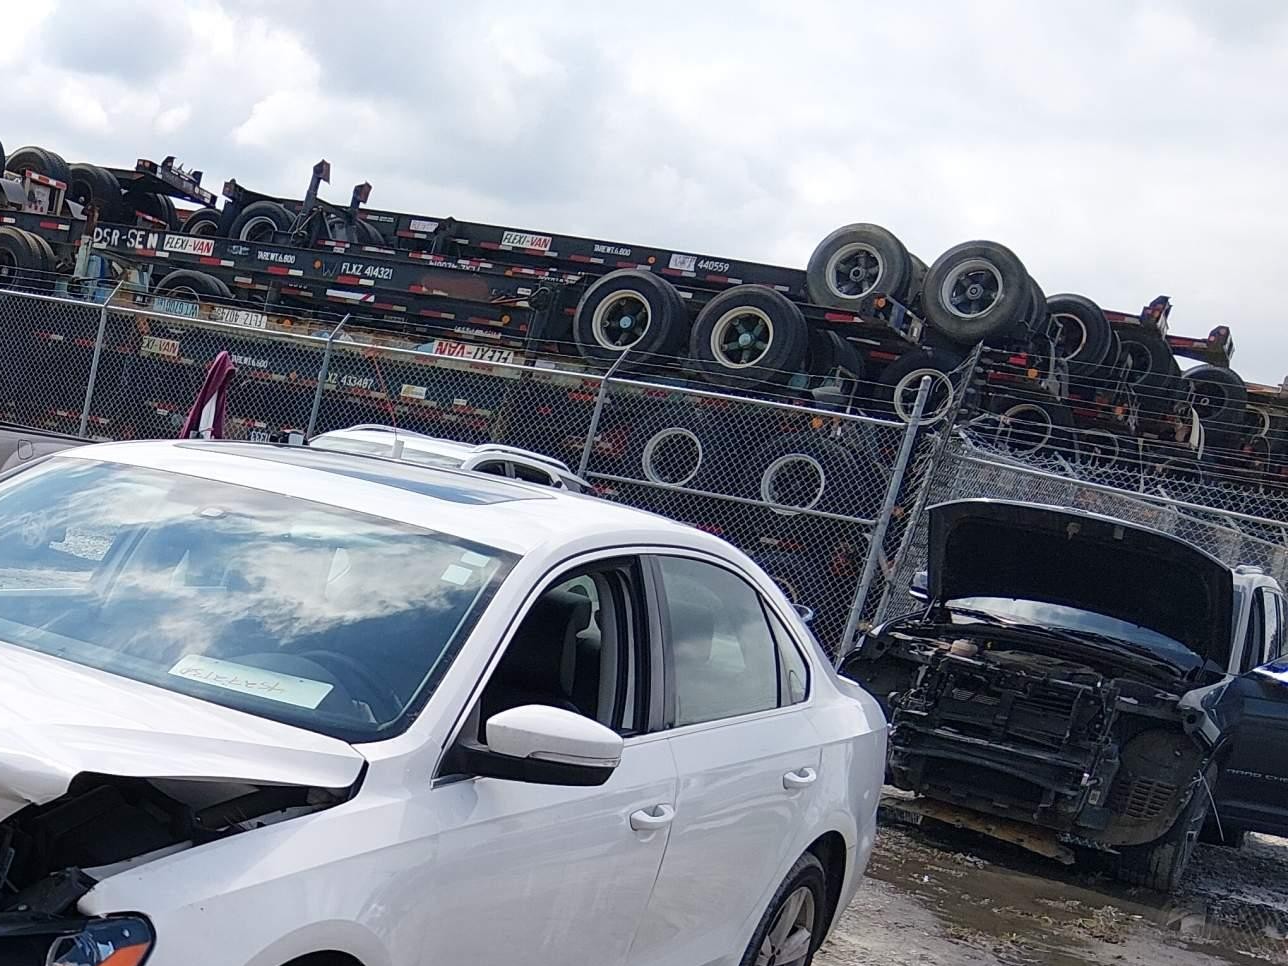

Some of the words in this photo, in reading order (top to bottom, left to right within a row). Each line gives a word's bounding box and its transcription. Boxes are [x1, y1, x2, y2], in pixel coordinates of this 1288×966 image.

[165, 236, 213, 254] FLEXI-VAN
[503, 232, 550, 249] FLEXI-VAN
[341, 262, 363, 275] FLXZ
[365, 265, 393, 280] 414321
[698, 260, 729, 272] 440559
[434, 341, 511, 364] FLEXI-VAN
